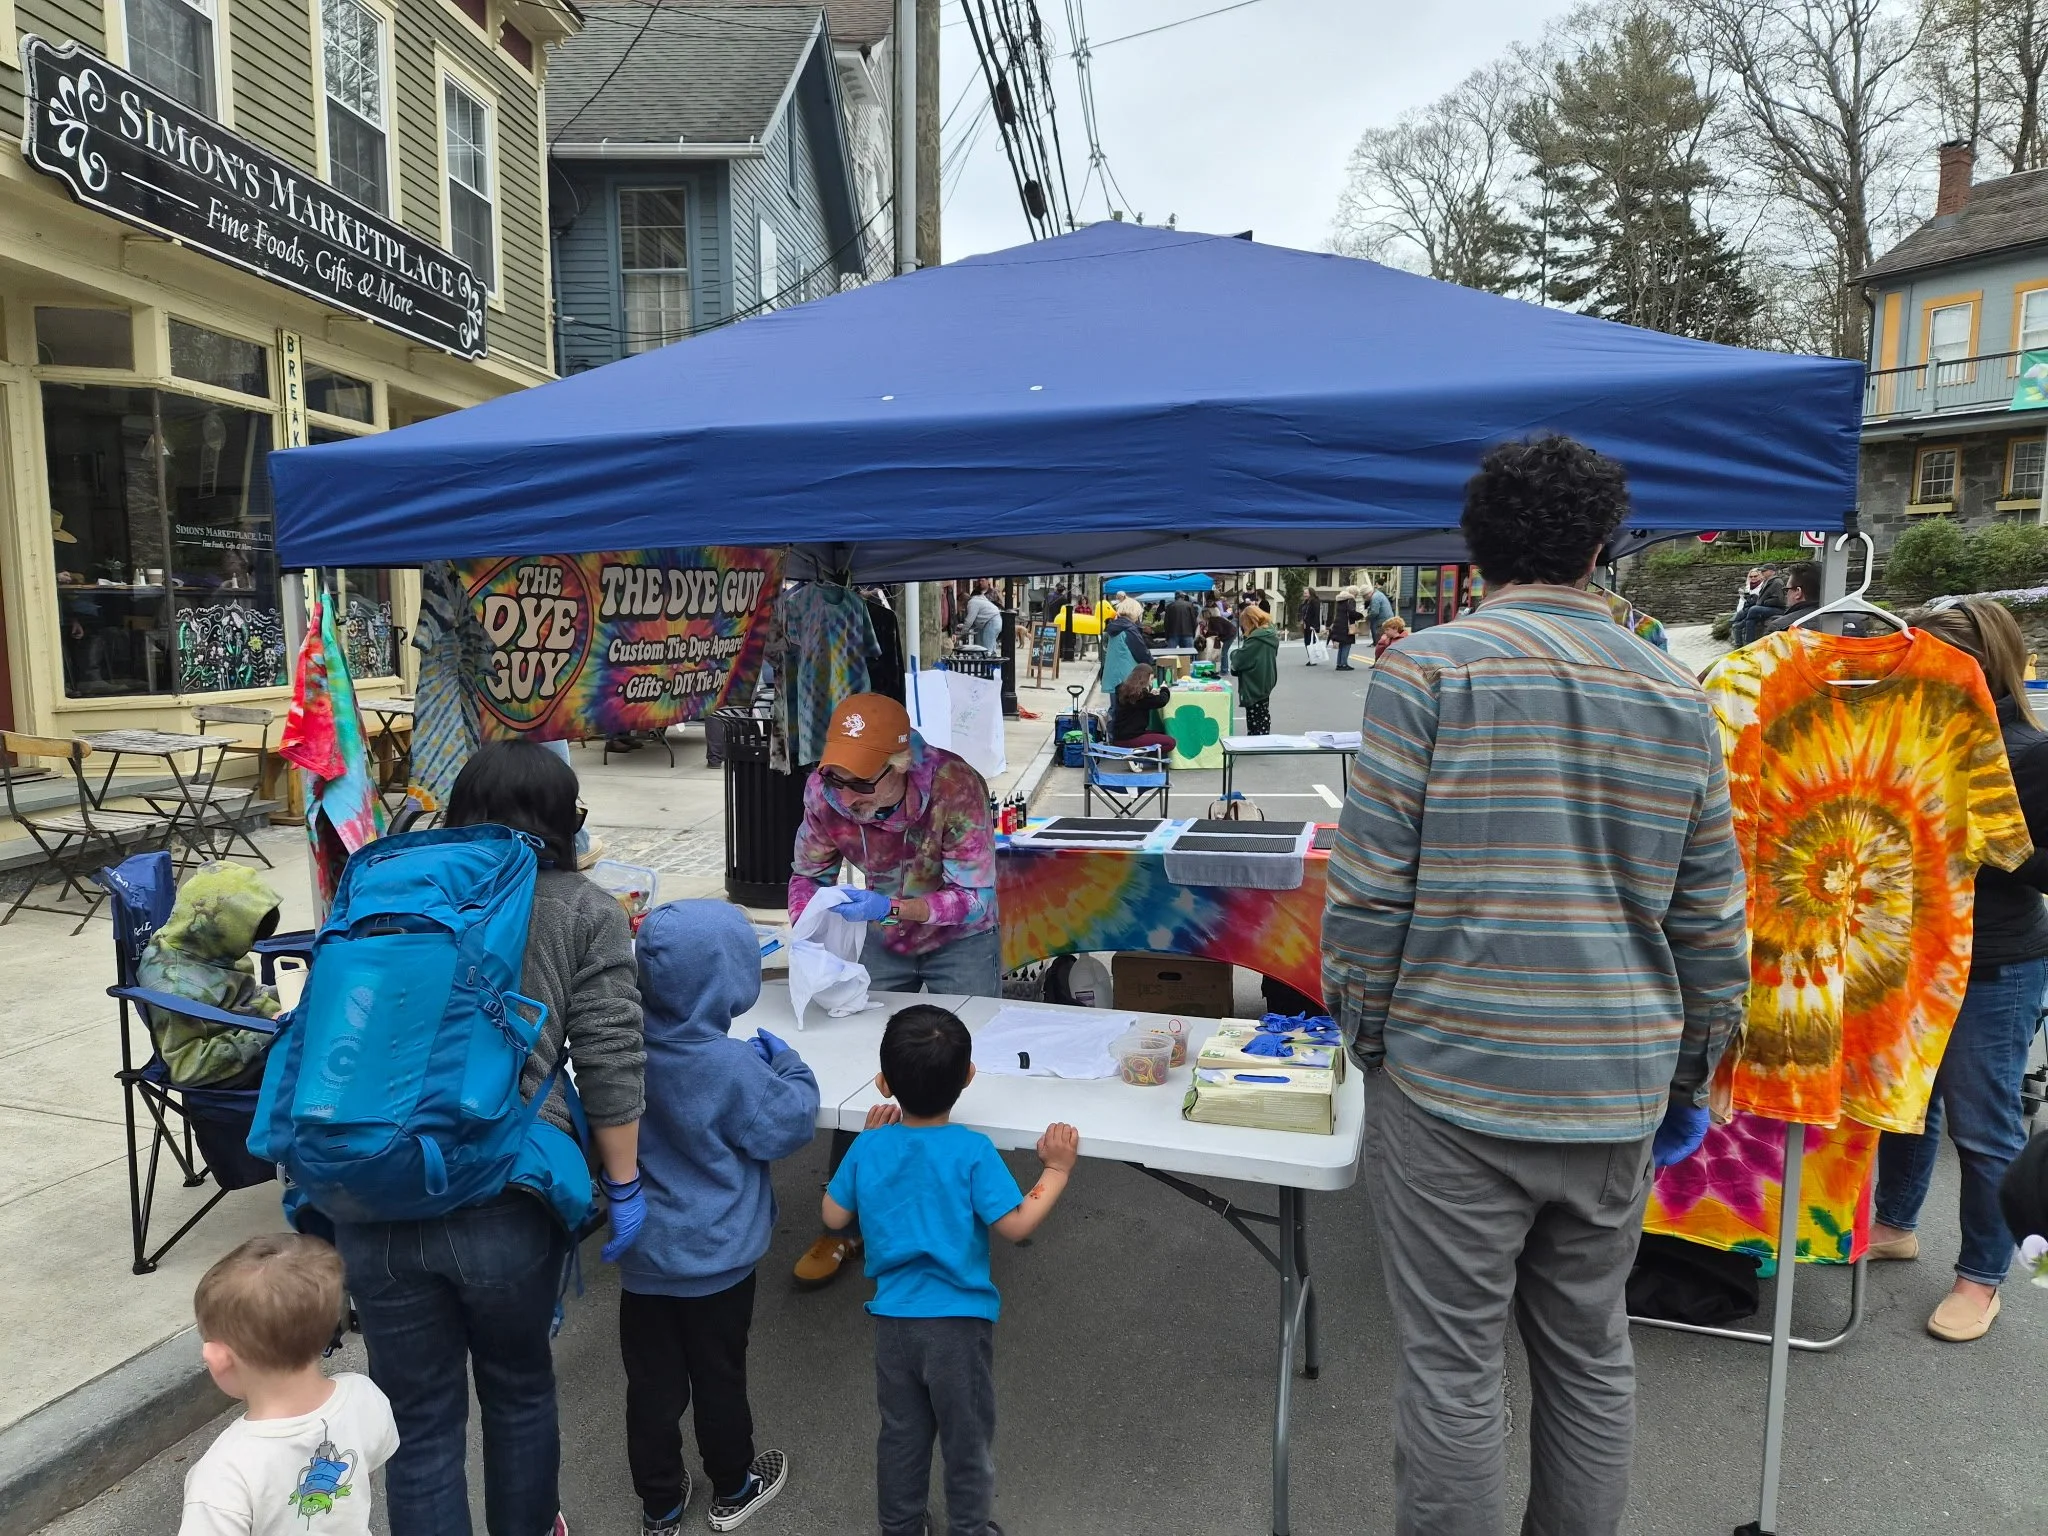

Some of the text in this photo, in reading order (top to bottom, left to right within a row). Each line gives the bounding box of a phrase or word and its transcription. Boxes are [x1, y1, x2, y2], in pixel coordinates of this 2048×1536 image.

[120, 90, 454, 297] SIMON'S MARKETPLACE
[206, 197, 414, 315] Fine Foods, Gifts & More
[518, 566, 562, 596] THE
[601, 566, 765, 616] THE DYE GUY
[483, 596, 578, 649] DYE
[608, 638, 665, 663] Custom
[667, 637, 687, 661] Tie
[688, 636, 710, 662] Dye
[486, 650, 571, 700] GUY
[626, 676, 663, 699] Gifts
[672, 671, 696, 696] DIY
[696, 670, 713, 692] Tie
